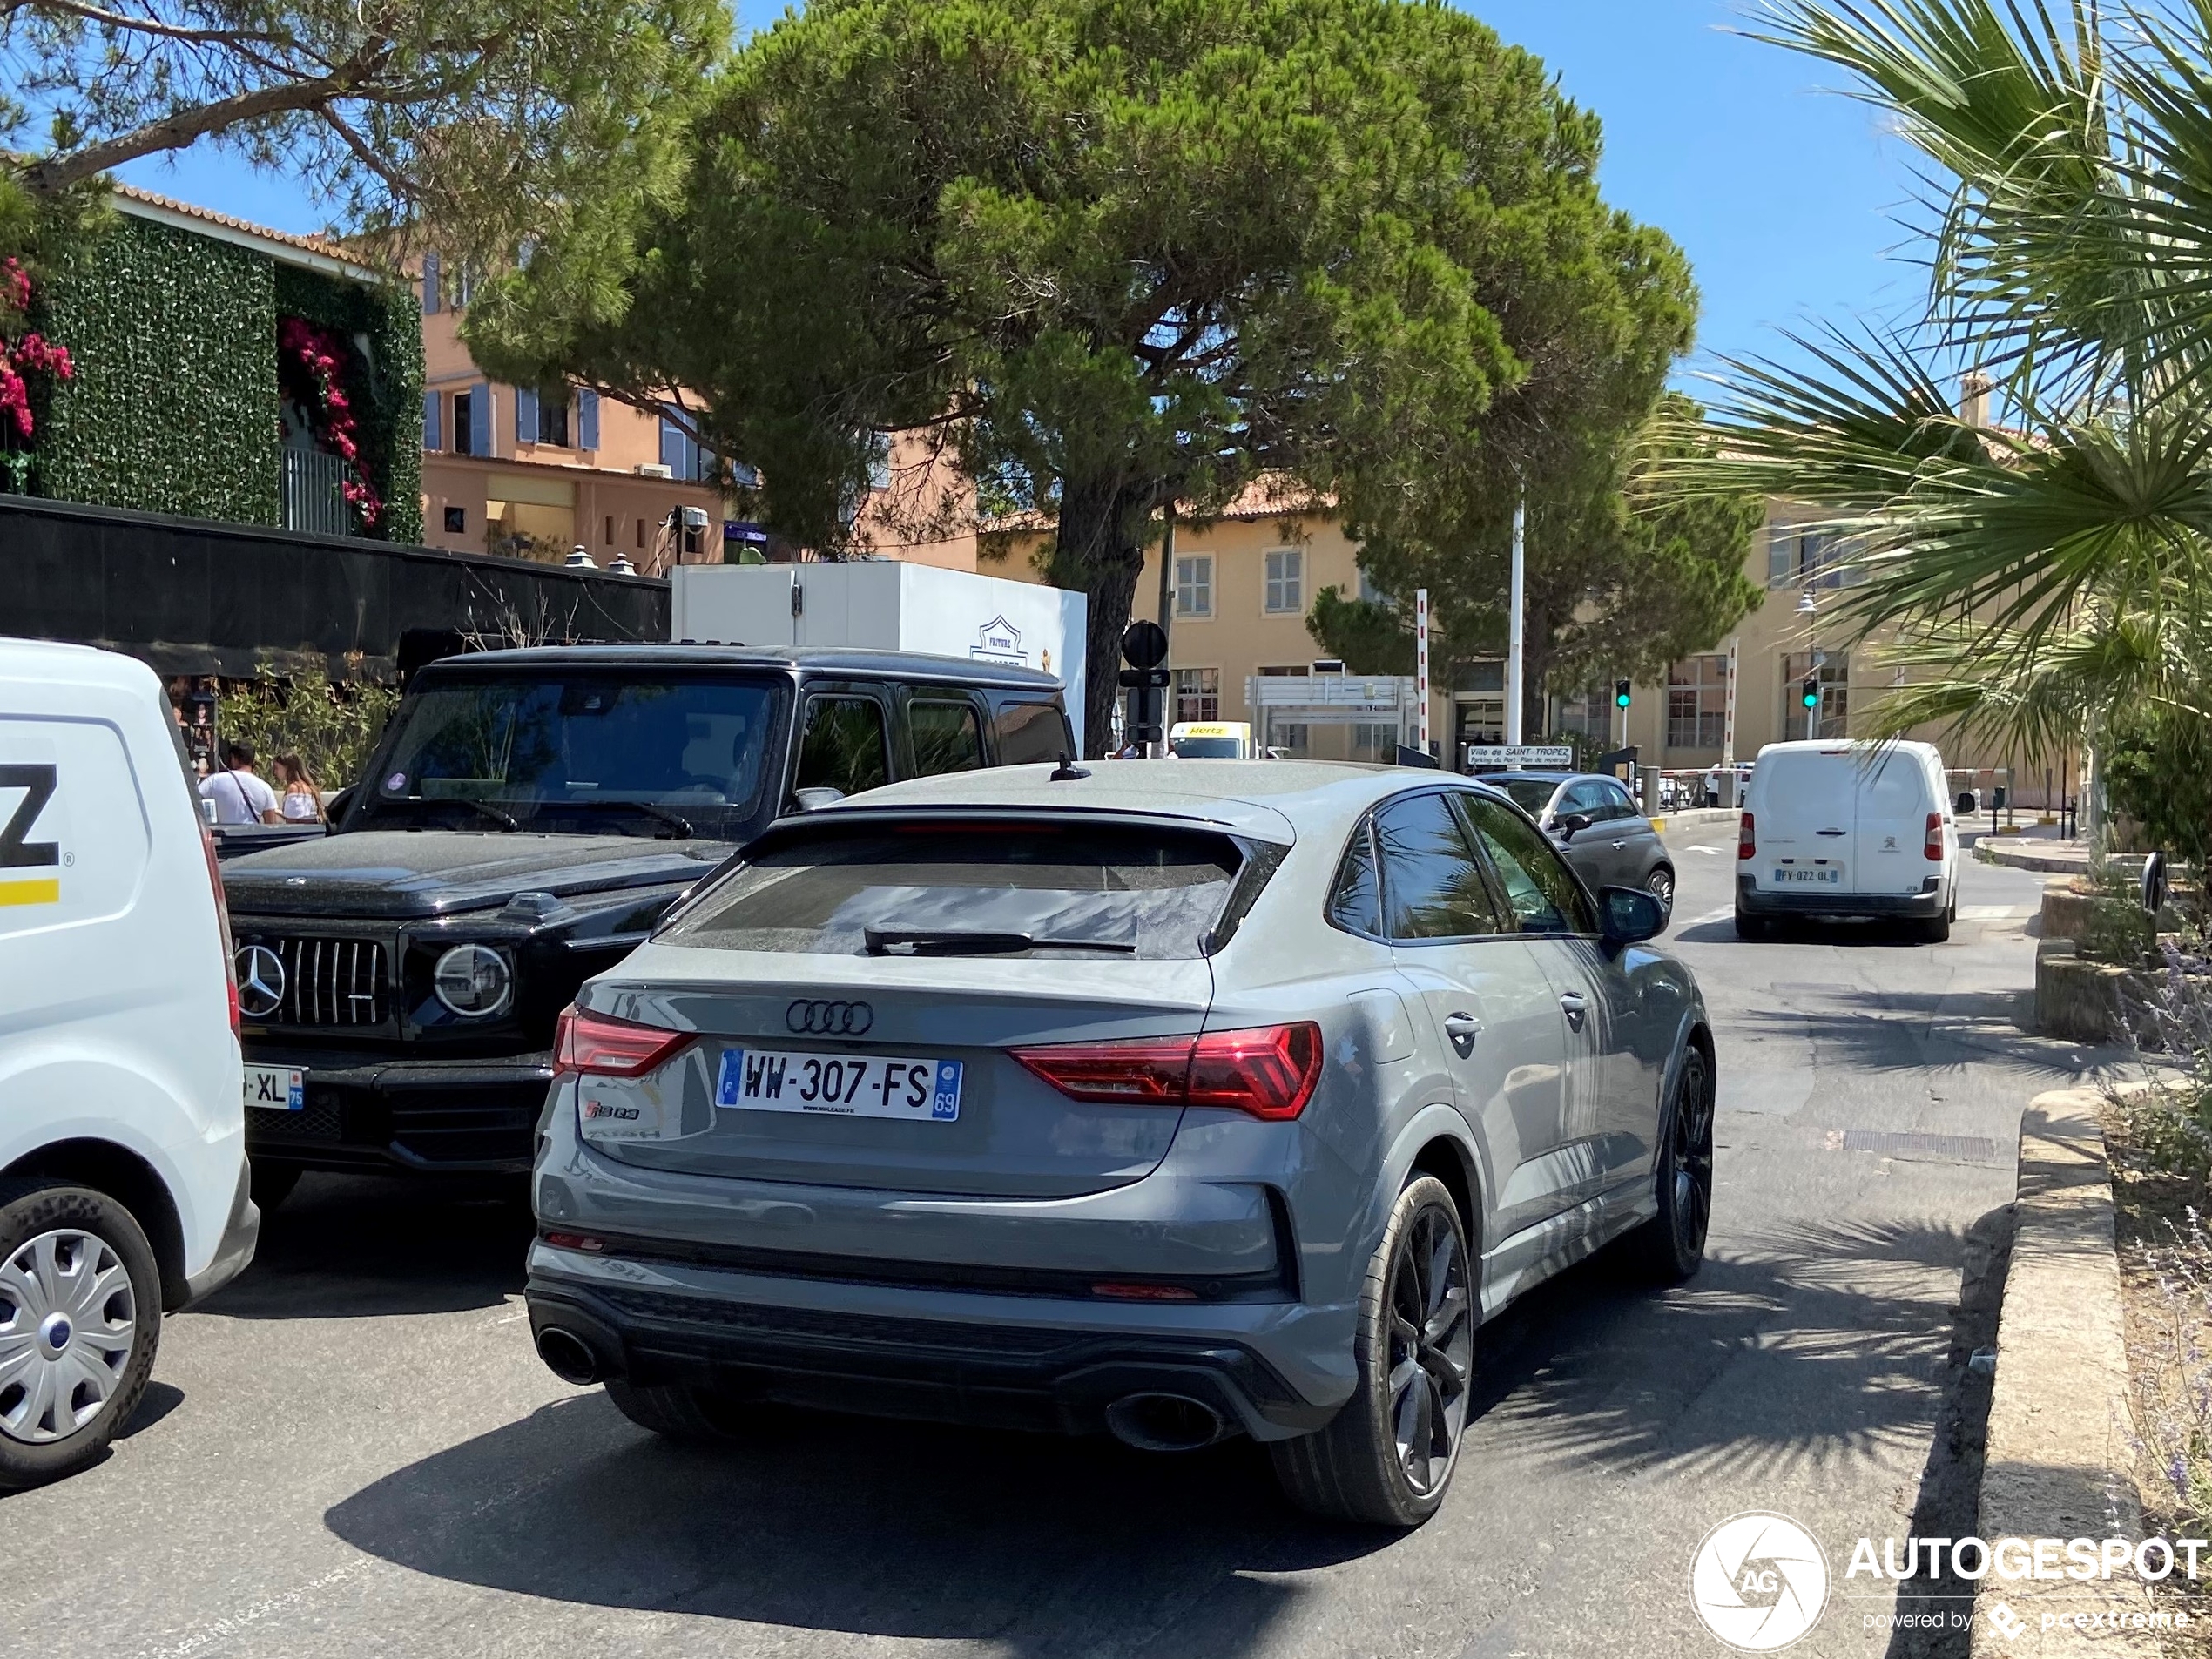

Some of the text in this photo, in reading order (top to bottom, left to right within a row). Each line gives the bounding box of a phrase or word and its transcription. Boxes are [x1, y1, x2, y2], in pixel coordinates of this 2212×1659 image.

[1190, 726, 1223, 735] Hertz
[745, 1055, 929, 1108] WW-307-FS
[290, 1091, 303, 1105] 75
[934, 1092, 956, 1113] 69
